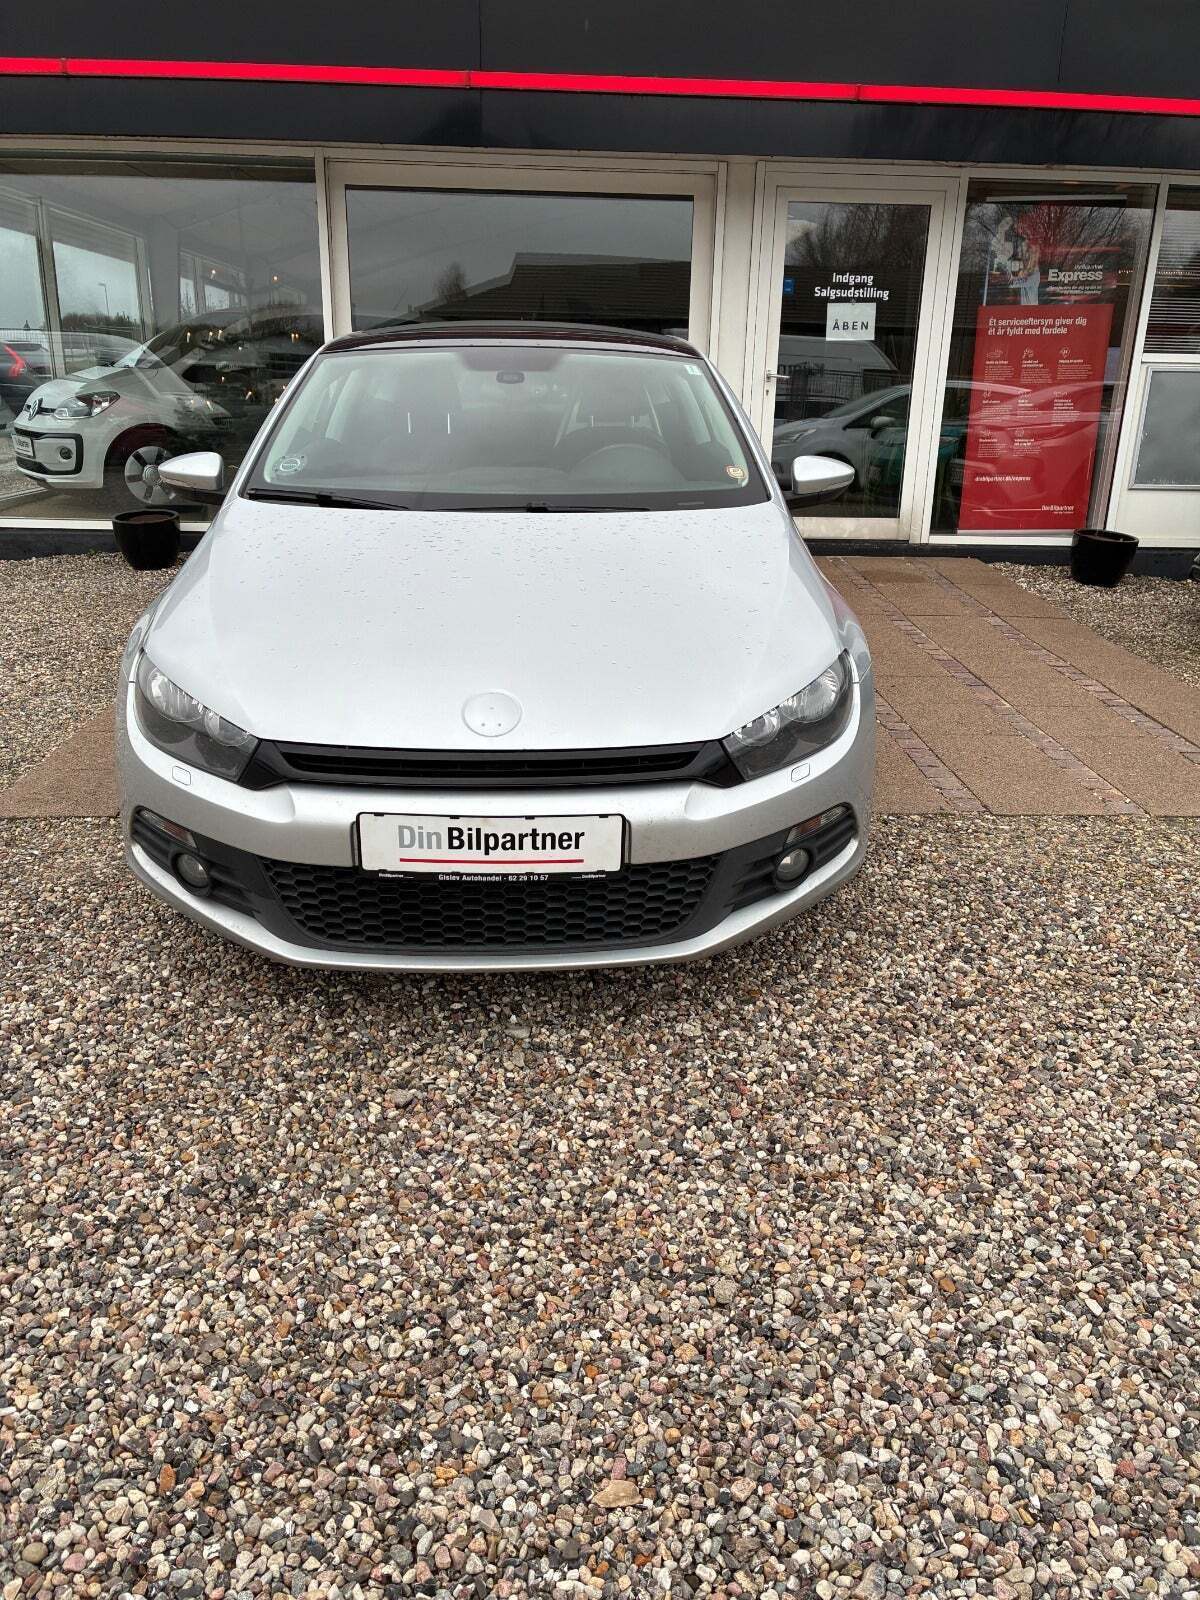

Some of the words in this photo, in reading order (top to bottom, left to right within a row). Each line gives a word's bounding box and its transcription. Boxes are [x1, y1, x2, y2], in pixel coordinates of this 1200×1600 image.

[832, 272, 874, 286] Indgang
[1047, 268, 1103, 284] Express
[814, 286, 890, 301] Salgsudstilling
[832, 318, 870, 331] ÅBEN
[998, 318, 1054, 327] serviceeftersyn
[1055, 317, 1074, 326] giver
[1075, 316, 1087, 326] dig
[997, 327, 1006, 336] år
[1006, 327, 1024, 336] fyldt
[1024, 327, 1040, 335] med
[1042, 326, 1068, 335] fordele
[398, 824, 442, 850] Din
[447, 826, 585, 856] Bilpartner
